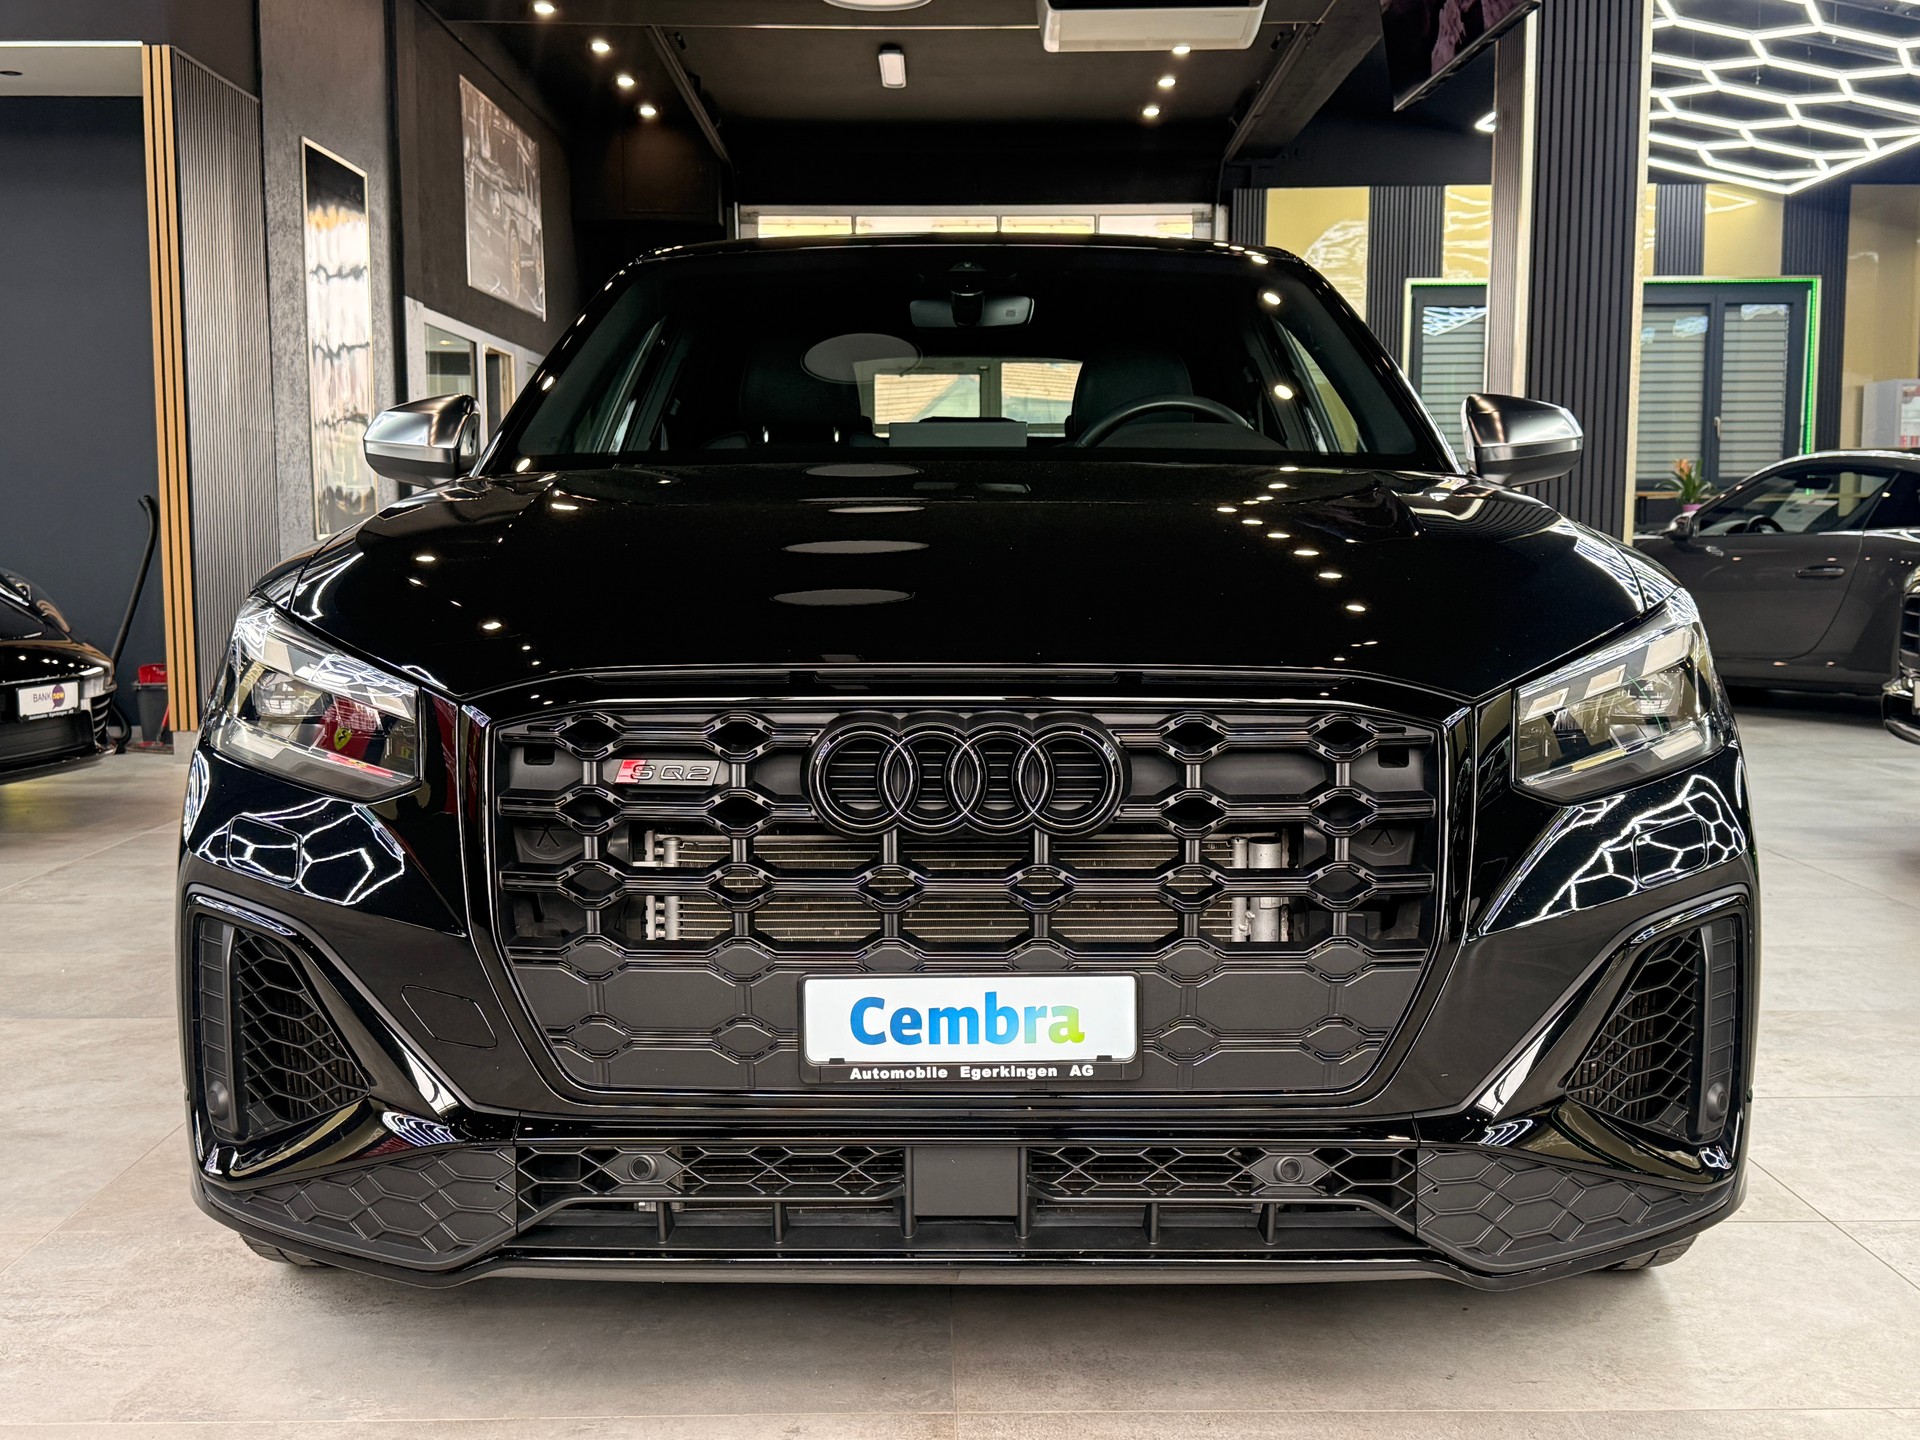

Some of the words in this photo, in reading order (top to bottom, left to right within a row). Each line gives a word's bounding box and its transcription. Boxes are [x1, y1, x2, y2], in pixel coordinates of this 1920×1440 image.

[33, 692, 51, 702] BANK
[630, 764, 711, 781] SQ2
[850, 991, 1085, 1045] Cembra
[849, 1066, 949, 1080] Automobile
[960, 1065, 1058, 1080] Egerkingen
[1069, 1064, 1094, 1077] AG
